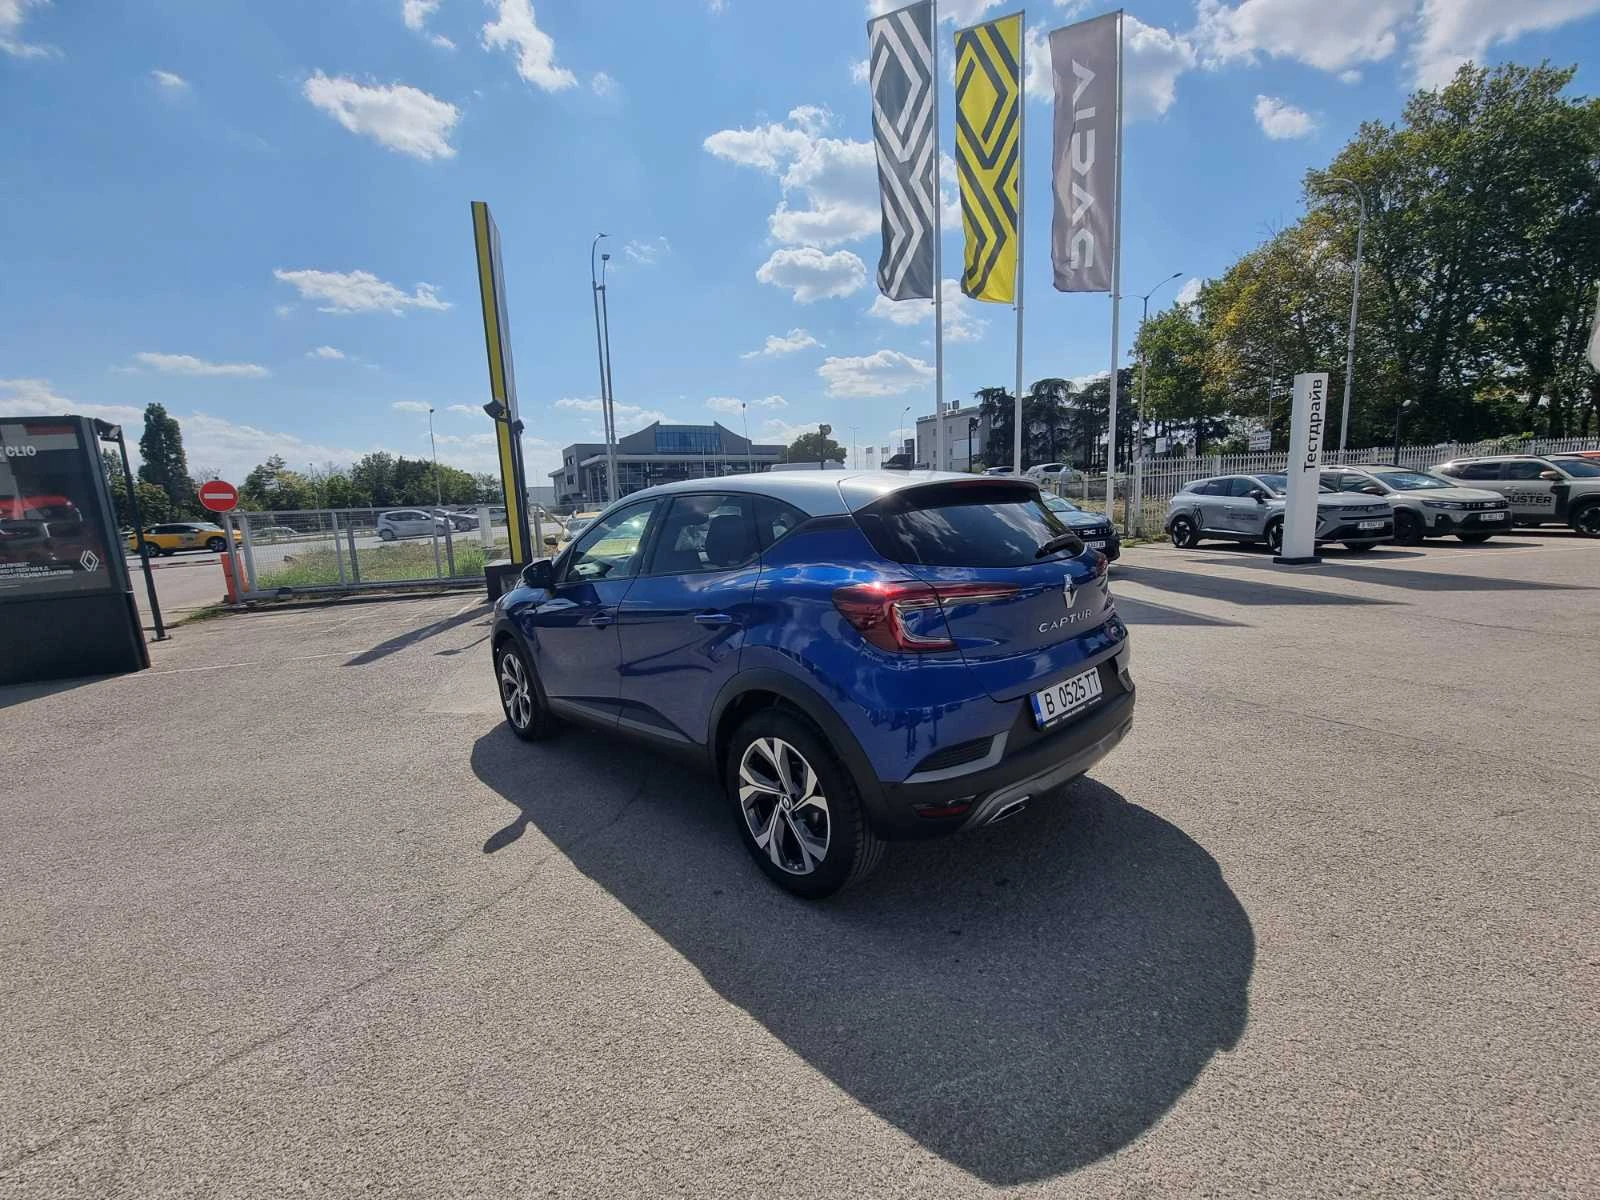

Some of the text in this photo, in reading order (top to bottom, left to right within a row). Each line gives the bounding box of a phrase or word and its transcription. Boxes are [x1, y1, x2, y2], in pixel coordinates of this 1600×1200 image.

[1303, 379, 1323, 473] Тестдрайв
[5, 445, 37, 457] CLIO
[1038, 608, 1093, 633] CAPTUR
[1058, 677, 1086, 708] 0525
